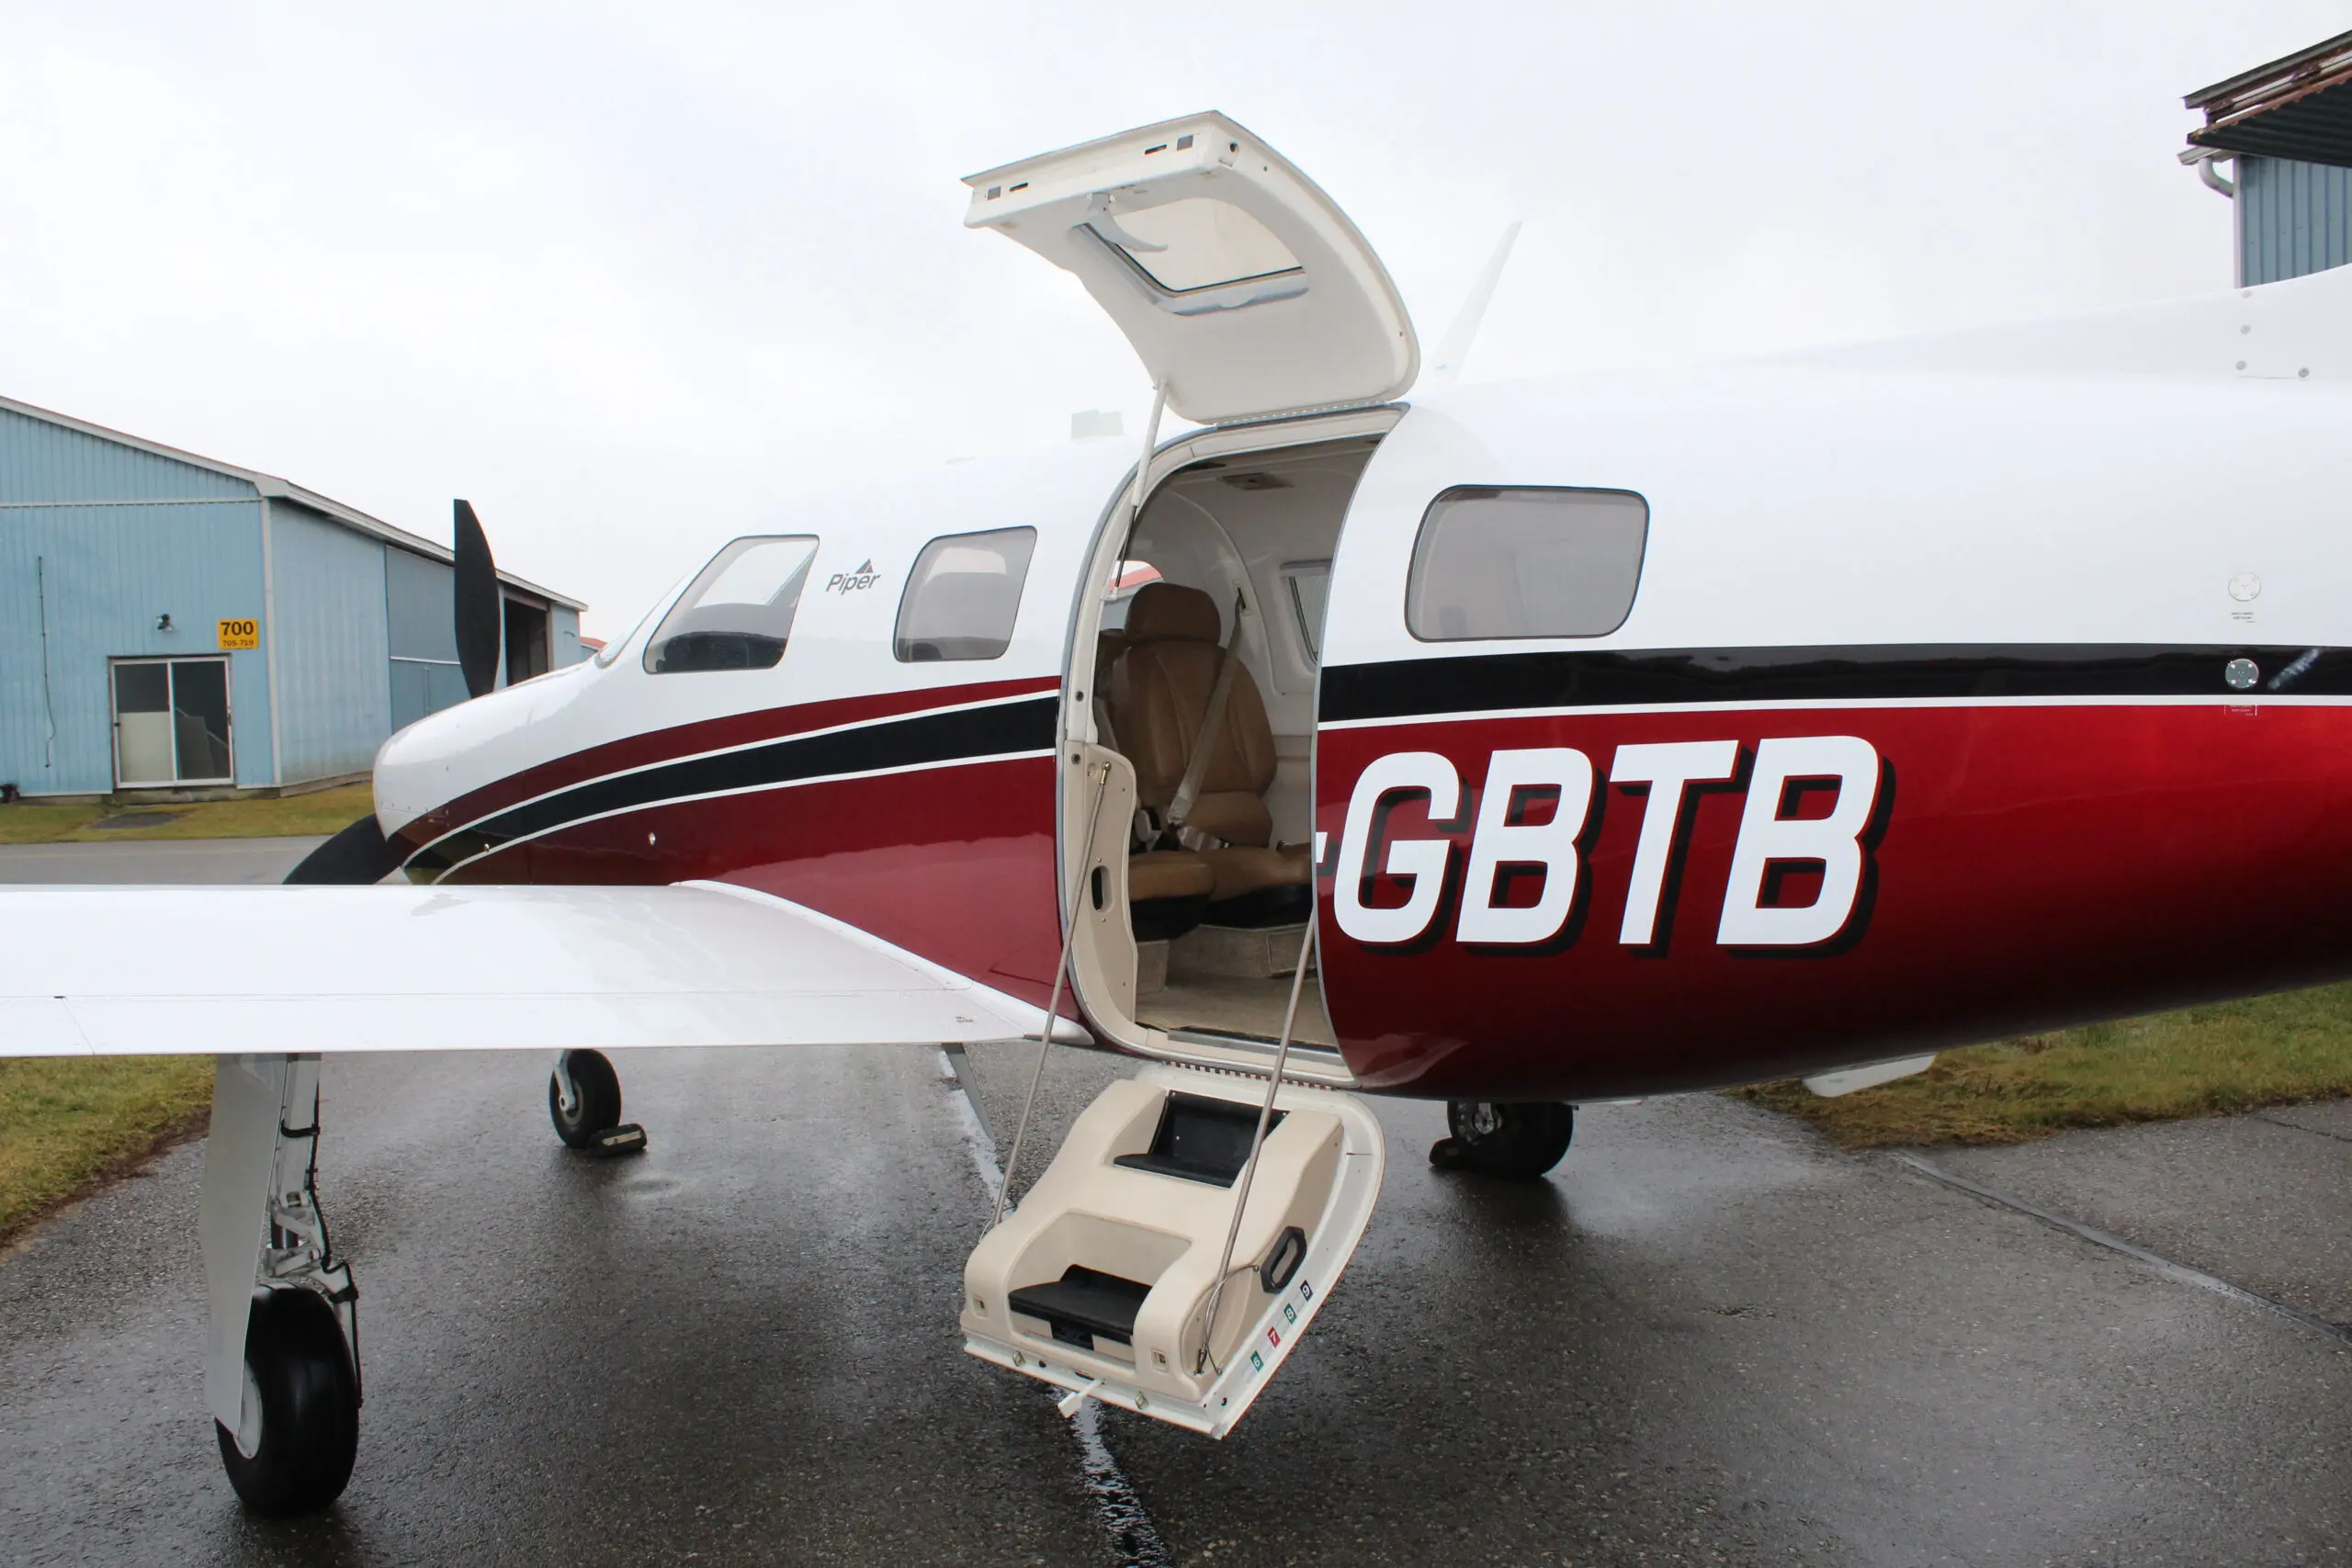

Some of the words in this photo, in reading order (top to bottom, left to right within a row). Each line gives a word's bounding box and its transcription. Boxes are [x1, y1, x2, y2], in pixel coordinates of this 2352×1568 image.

[826, 573, 881, 595] Piper
[220, 621, 254, 636] 700
[1317, 735, 1893, 955] GBTB
